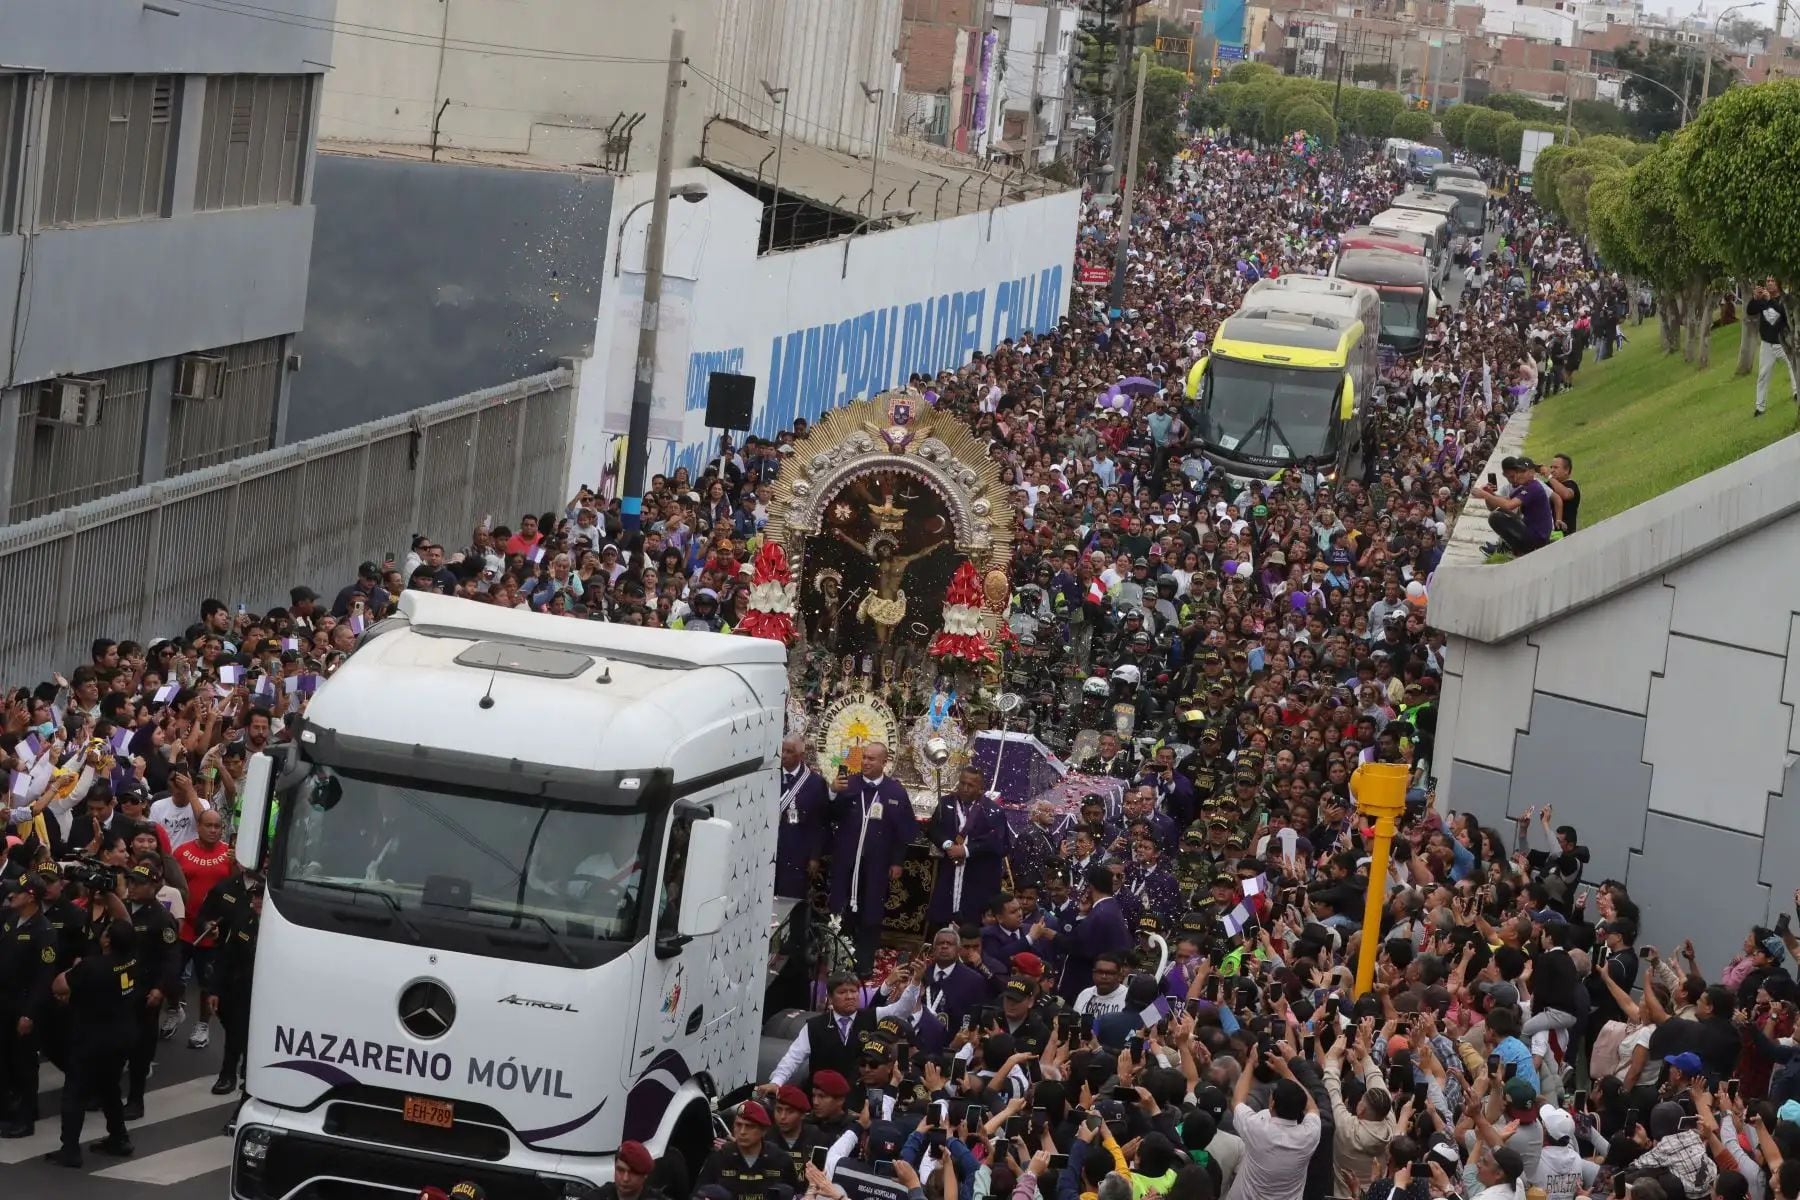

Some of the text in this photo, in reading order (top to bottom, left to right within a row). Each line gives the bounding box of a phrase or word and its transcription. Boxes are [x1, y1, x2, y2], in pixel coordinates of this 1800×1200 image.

[817, 694, 865, 753] MUNICIPALIDAD
[182, 850, 229, 867] BURBERRY
[38, 862, 58, 874] POLICIA
[1007, 980, 1026, 992] POLICIA
[274, 1025, 573, 1099] NAZARENO MÓVIL
